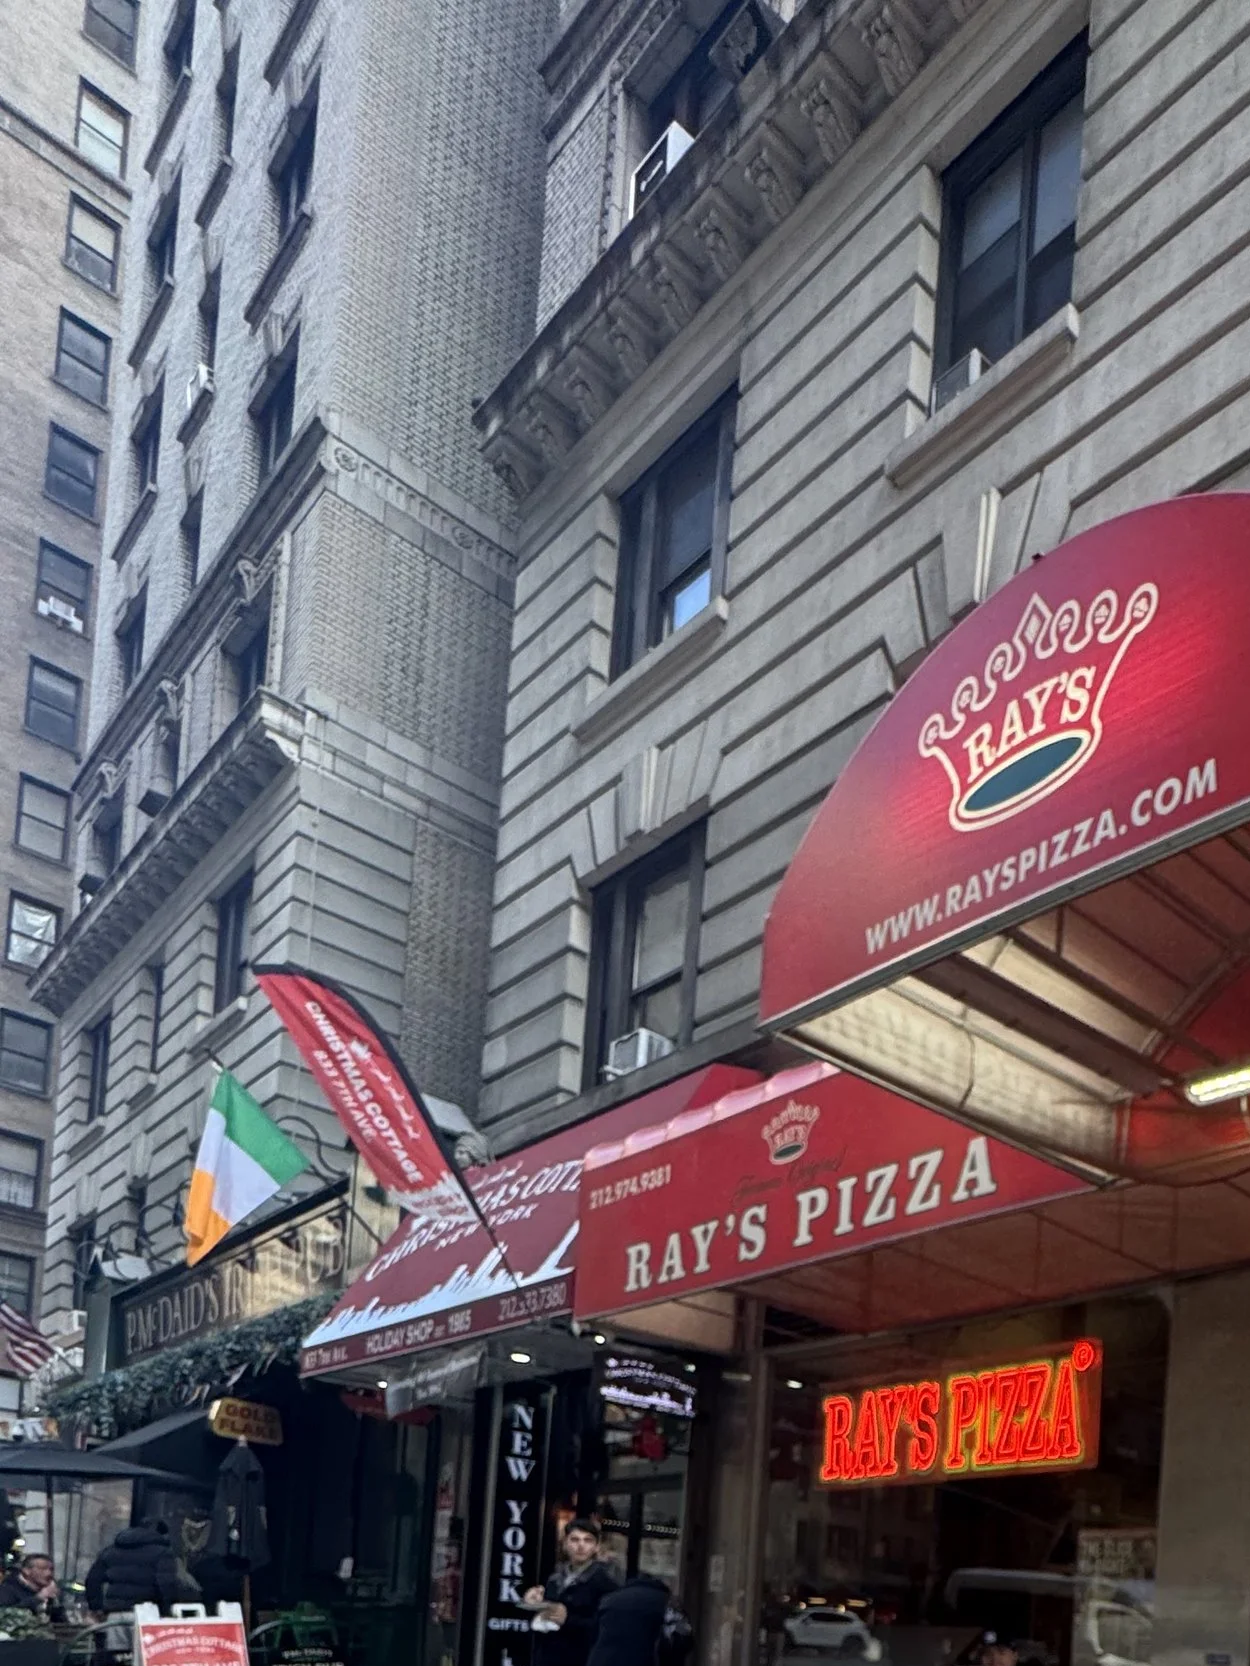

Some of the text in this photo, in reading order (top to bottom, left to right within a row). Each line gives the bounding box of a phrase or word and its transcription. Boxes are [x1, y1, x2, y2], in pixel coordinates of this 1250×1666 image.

[963, 663, 1097, 784] RAY'S
[864, 758, 1219, 956] WWW.RAYSPIZZA.COM
[305, 1000, 424, 1184] CHRISTMAS COTTAGE
[589, 1163, 673, 1210] 212.974.9381
[623, 1135, 997, 1293] RAY'S PIZZA
[821, 1381, 941, 1482] RAY'S
[499, 1403, 537, 1603] NEW YORK
[488, 1618, 531, 1633] GIFTS
